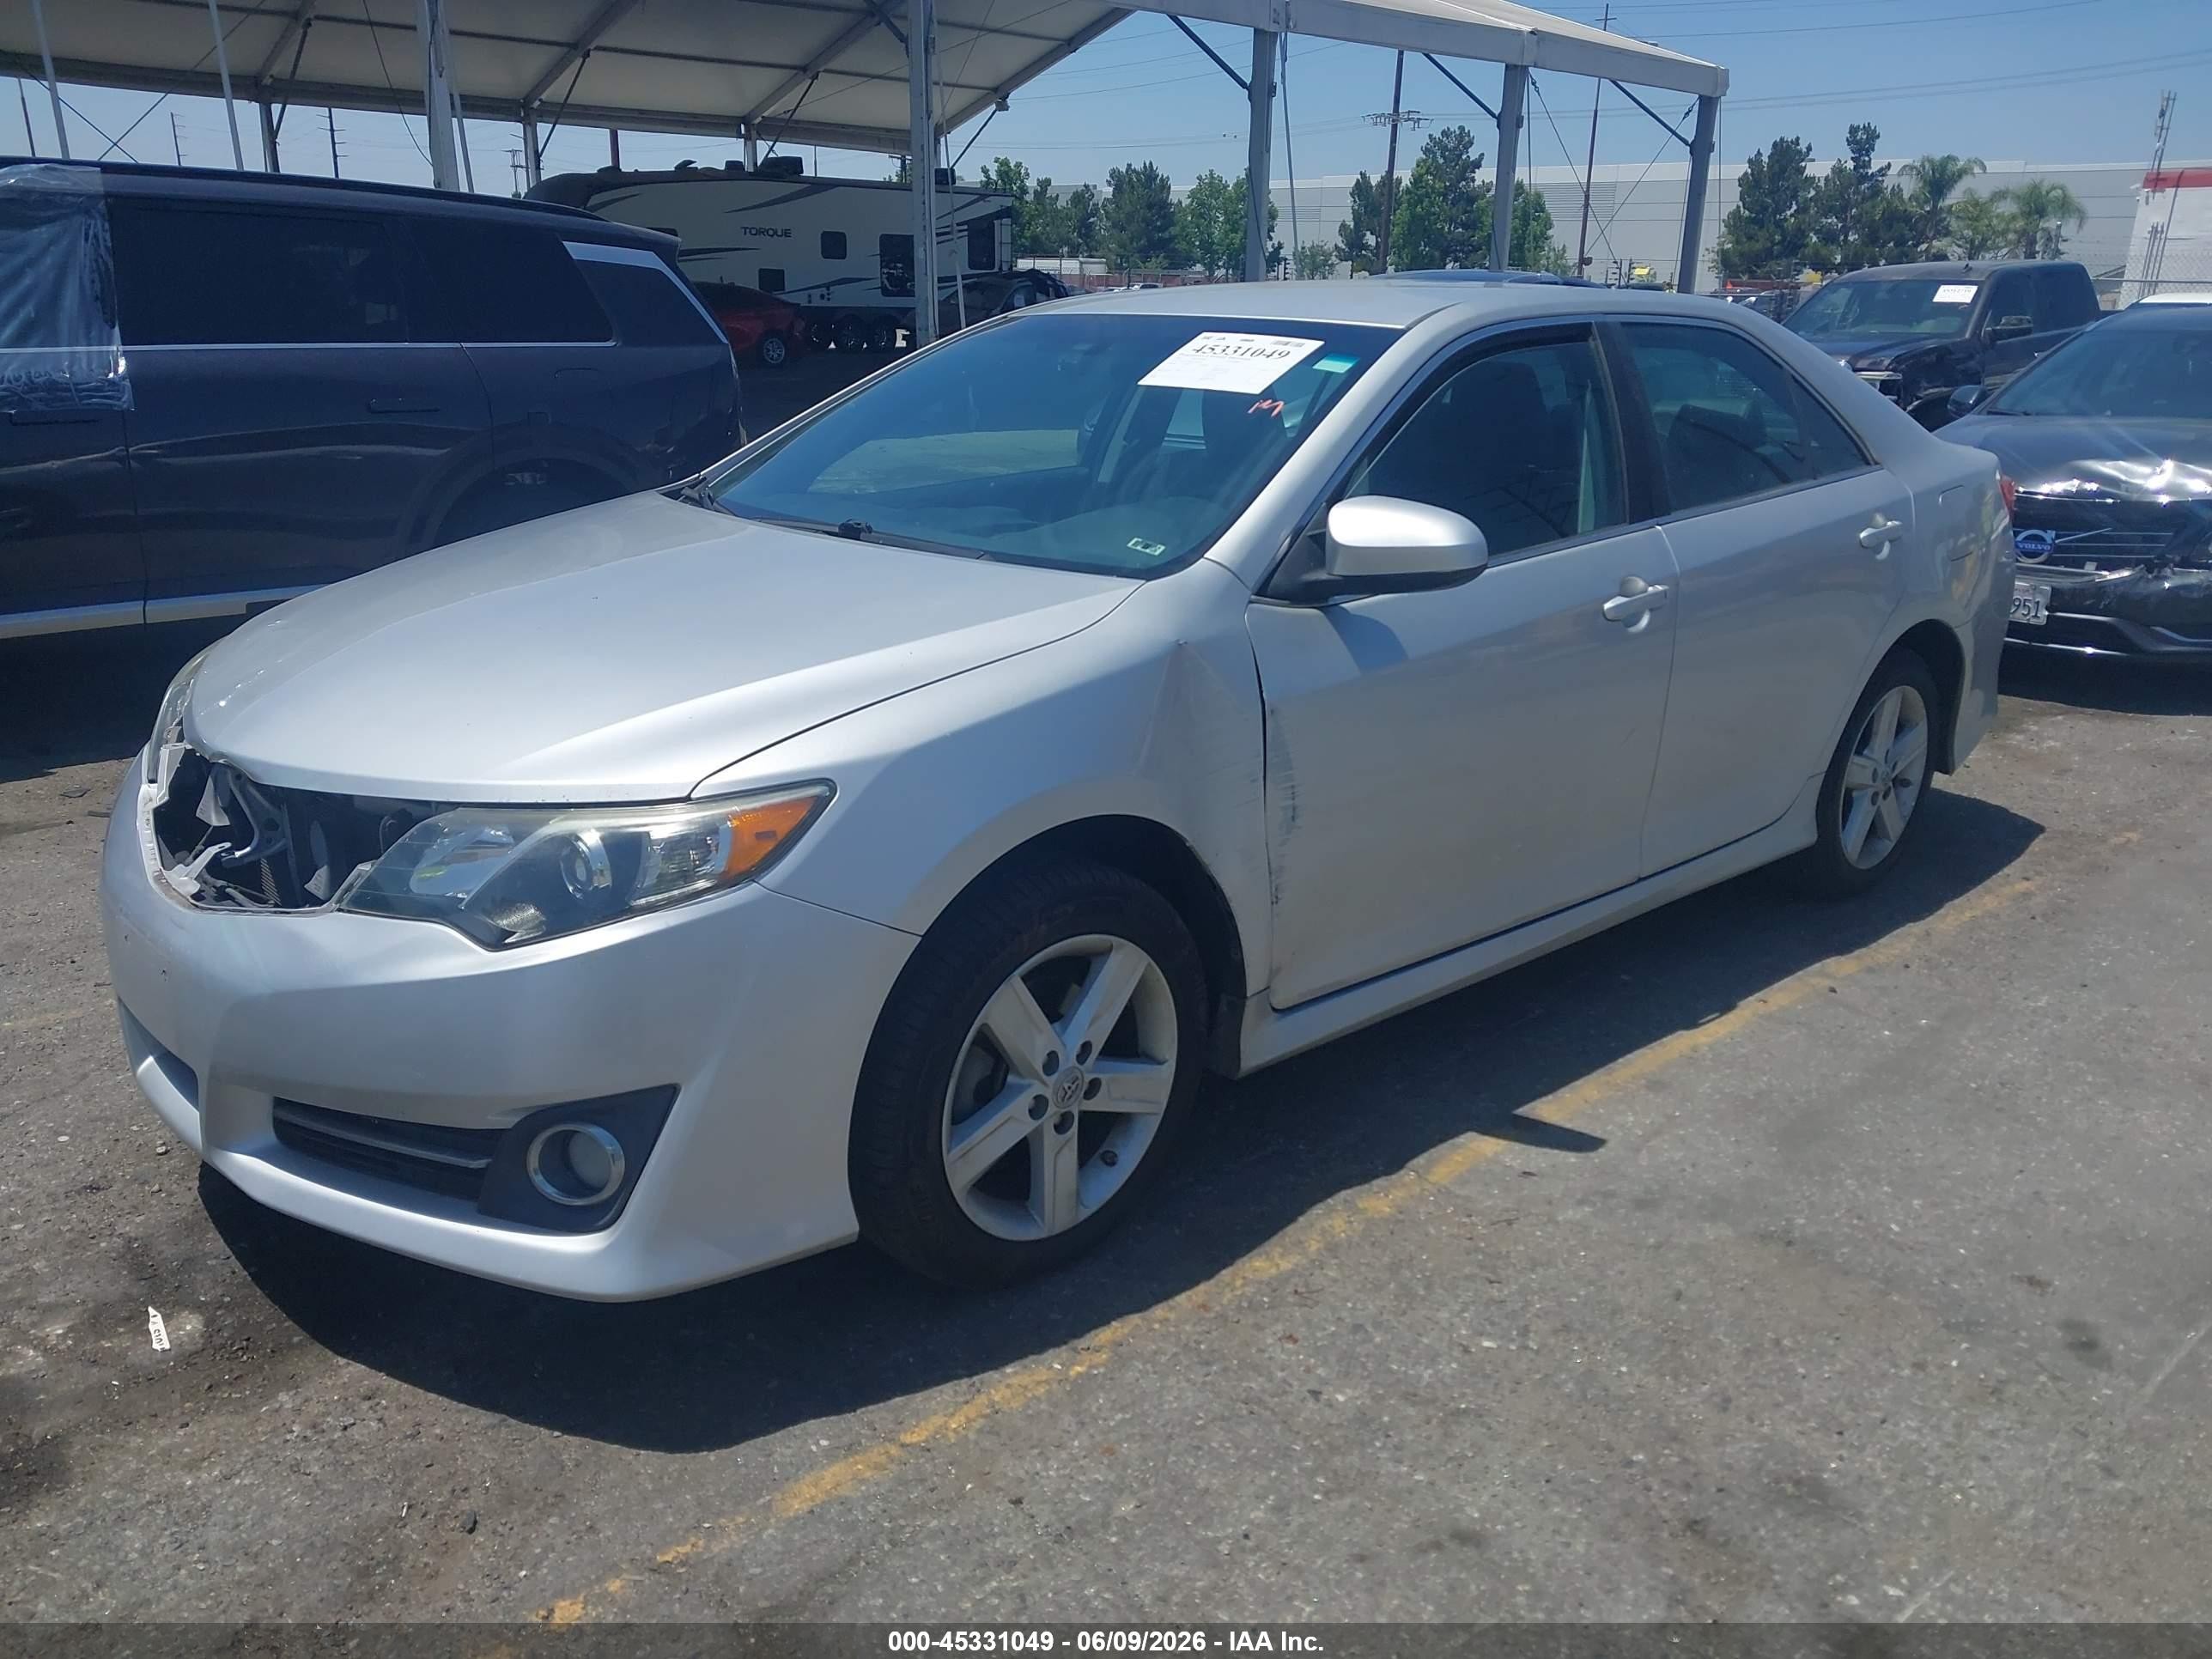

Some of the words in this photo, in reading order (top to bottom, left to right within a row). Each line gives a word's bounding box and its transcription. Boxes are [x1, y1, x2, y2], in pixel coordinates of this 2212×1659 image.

[740, 226, 792, 238] TORQUE
[1192, 343, 1291, 360] 45331049
[2018, 542, 2051, 551] VOLVO
